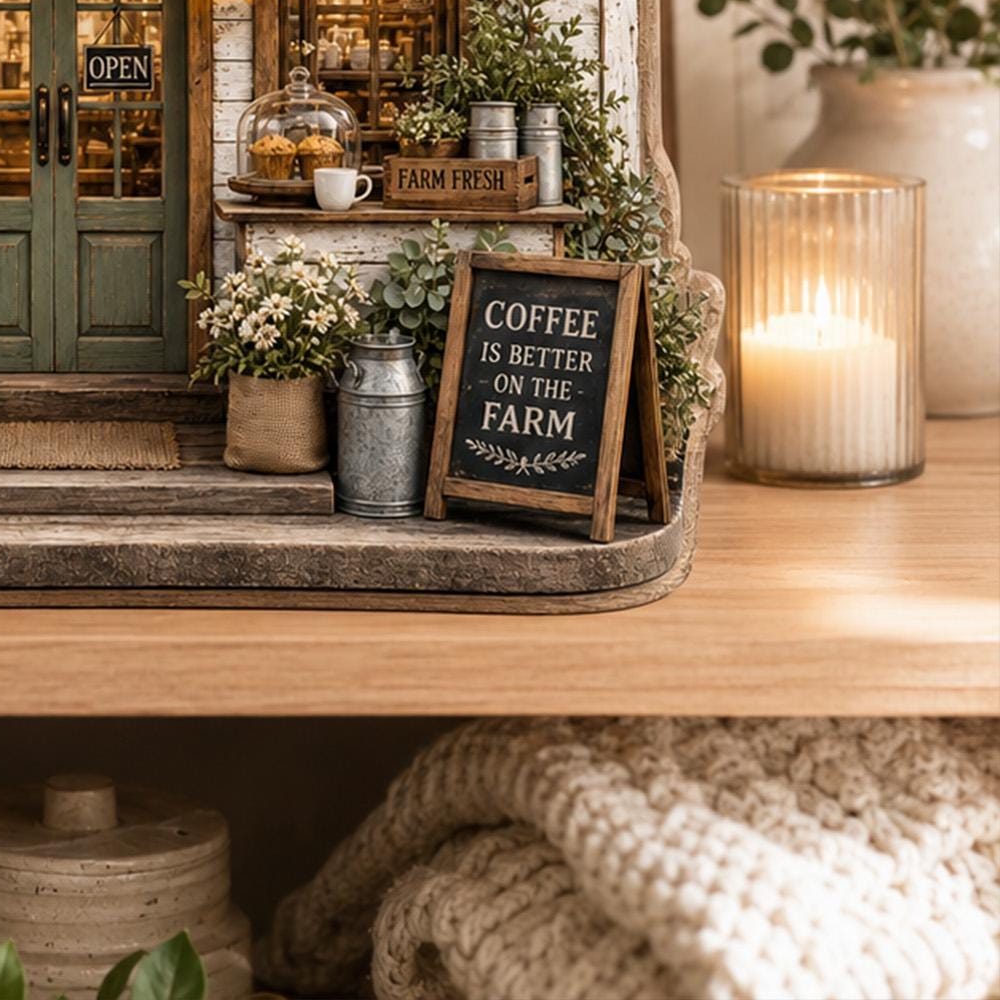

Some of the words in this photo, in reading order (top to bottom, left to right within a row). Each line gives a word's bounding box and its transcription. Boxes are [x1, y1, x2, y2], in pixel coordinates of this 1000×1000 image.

[88, 55, 148, 80] OPEN
[398, 168, 446, 190] FARM
[452, 168, 506, 191] FRESH
[484, 299, 600, 340] COFFEE
[480, 341, 502, 363] IS
[508, 343, 594, 373] BETTER
[493, 372, 524, 396] ON
[531, 376, 573, 402] THE
[480, 400, 577, 441] FARM
